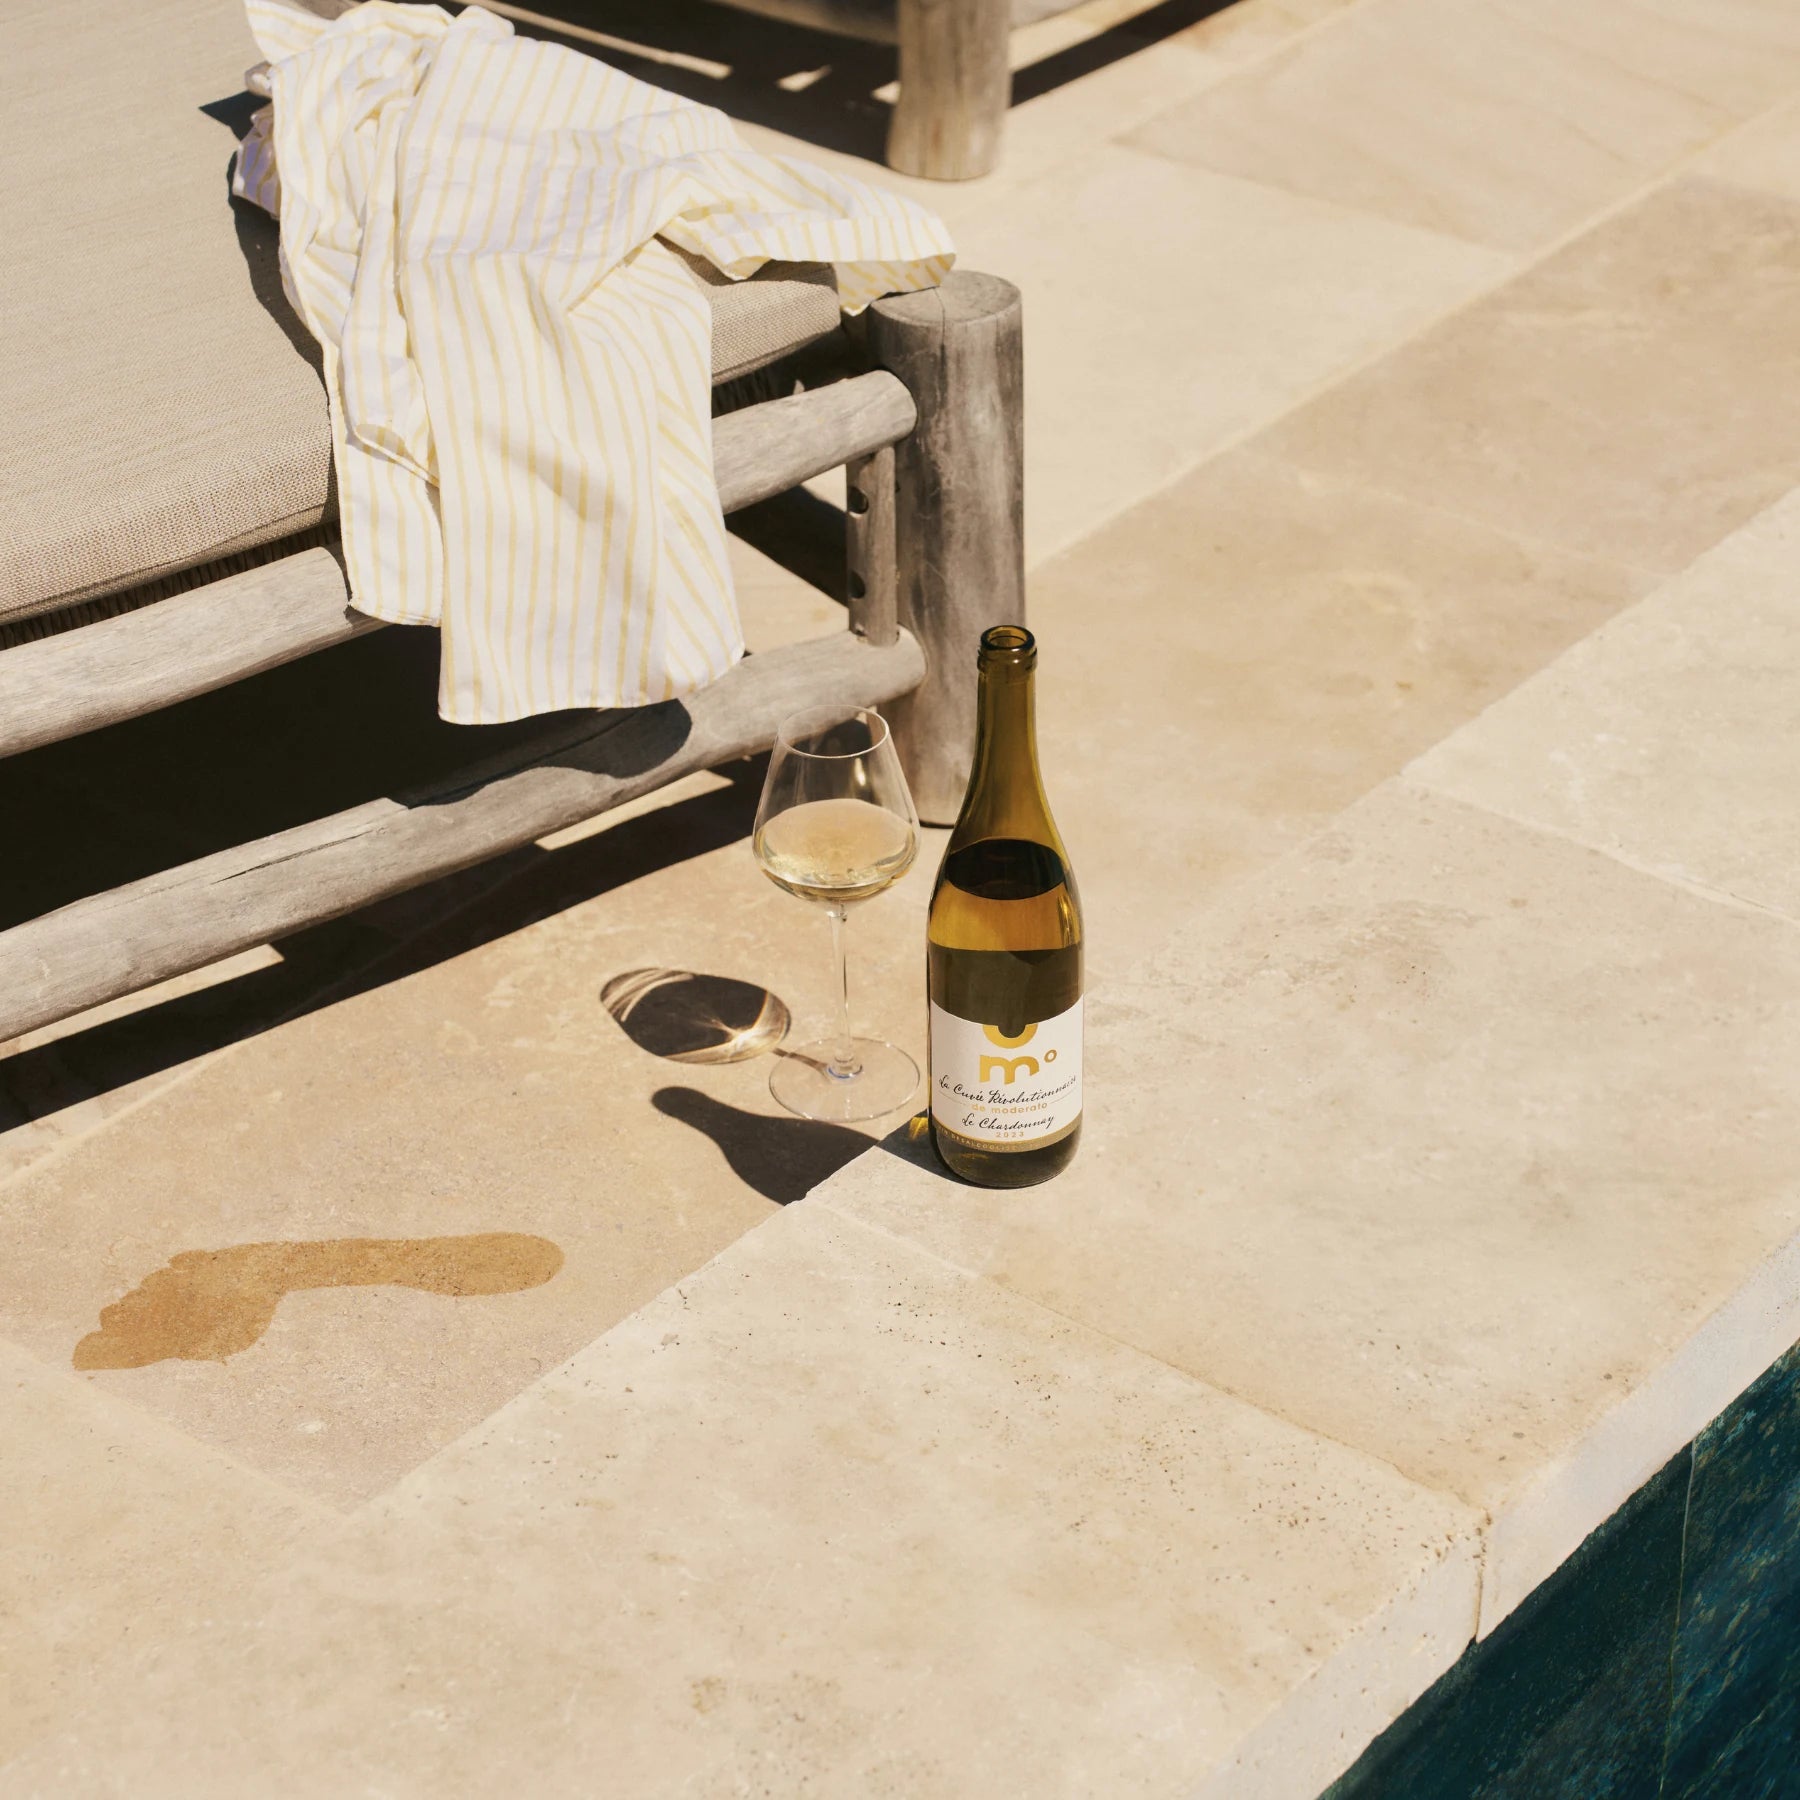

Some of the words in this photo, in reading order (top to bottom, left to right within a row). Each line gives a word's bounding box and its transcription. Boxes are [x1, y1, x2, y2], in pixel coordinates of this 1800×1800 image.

[938, 1074, 950, 1089] La
[953, 1083, 984, 1102] Cuvée
[971, 1103, 986, 1112] de
[991, 1102, 1048, 1114] moderato
[962, 1113, 975, 1126] Le
[979, 1115, 1054, 1130] Chardonnay
